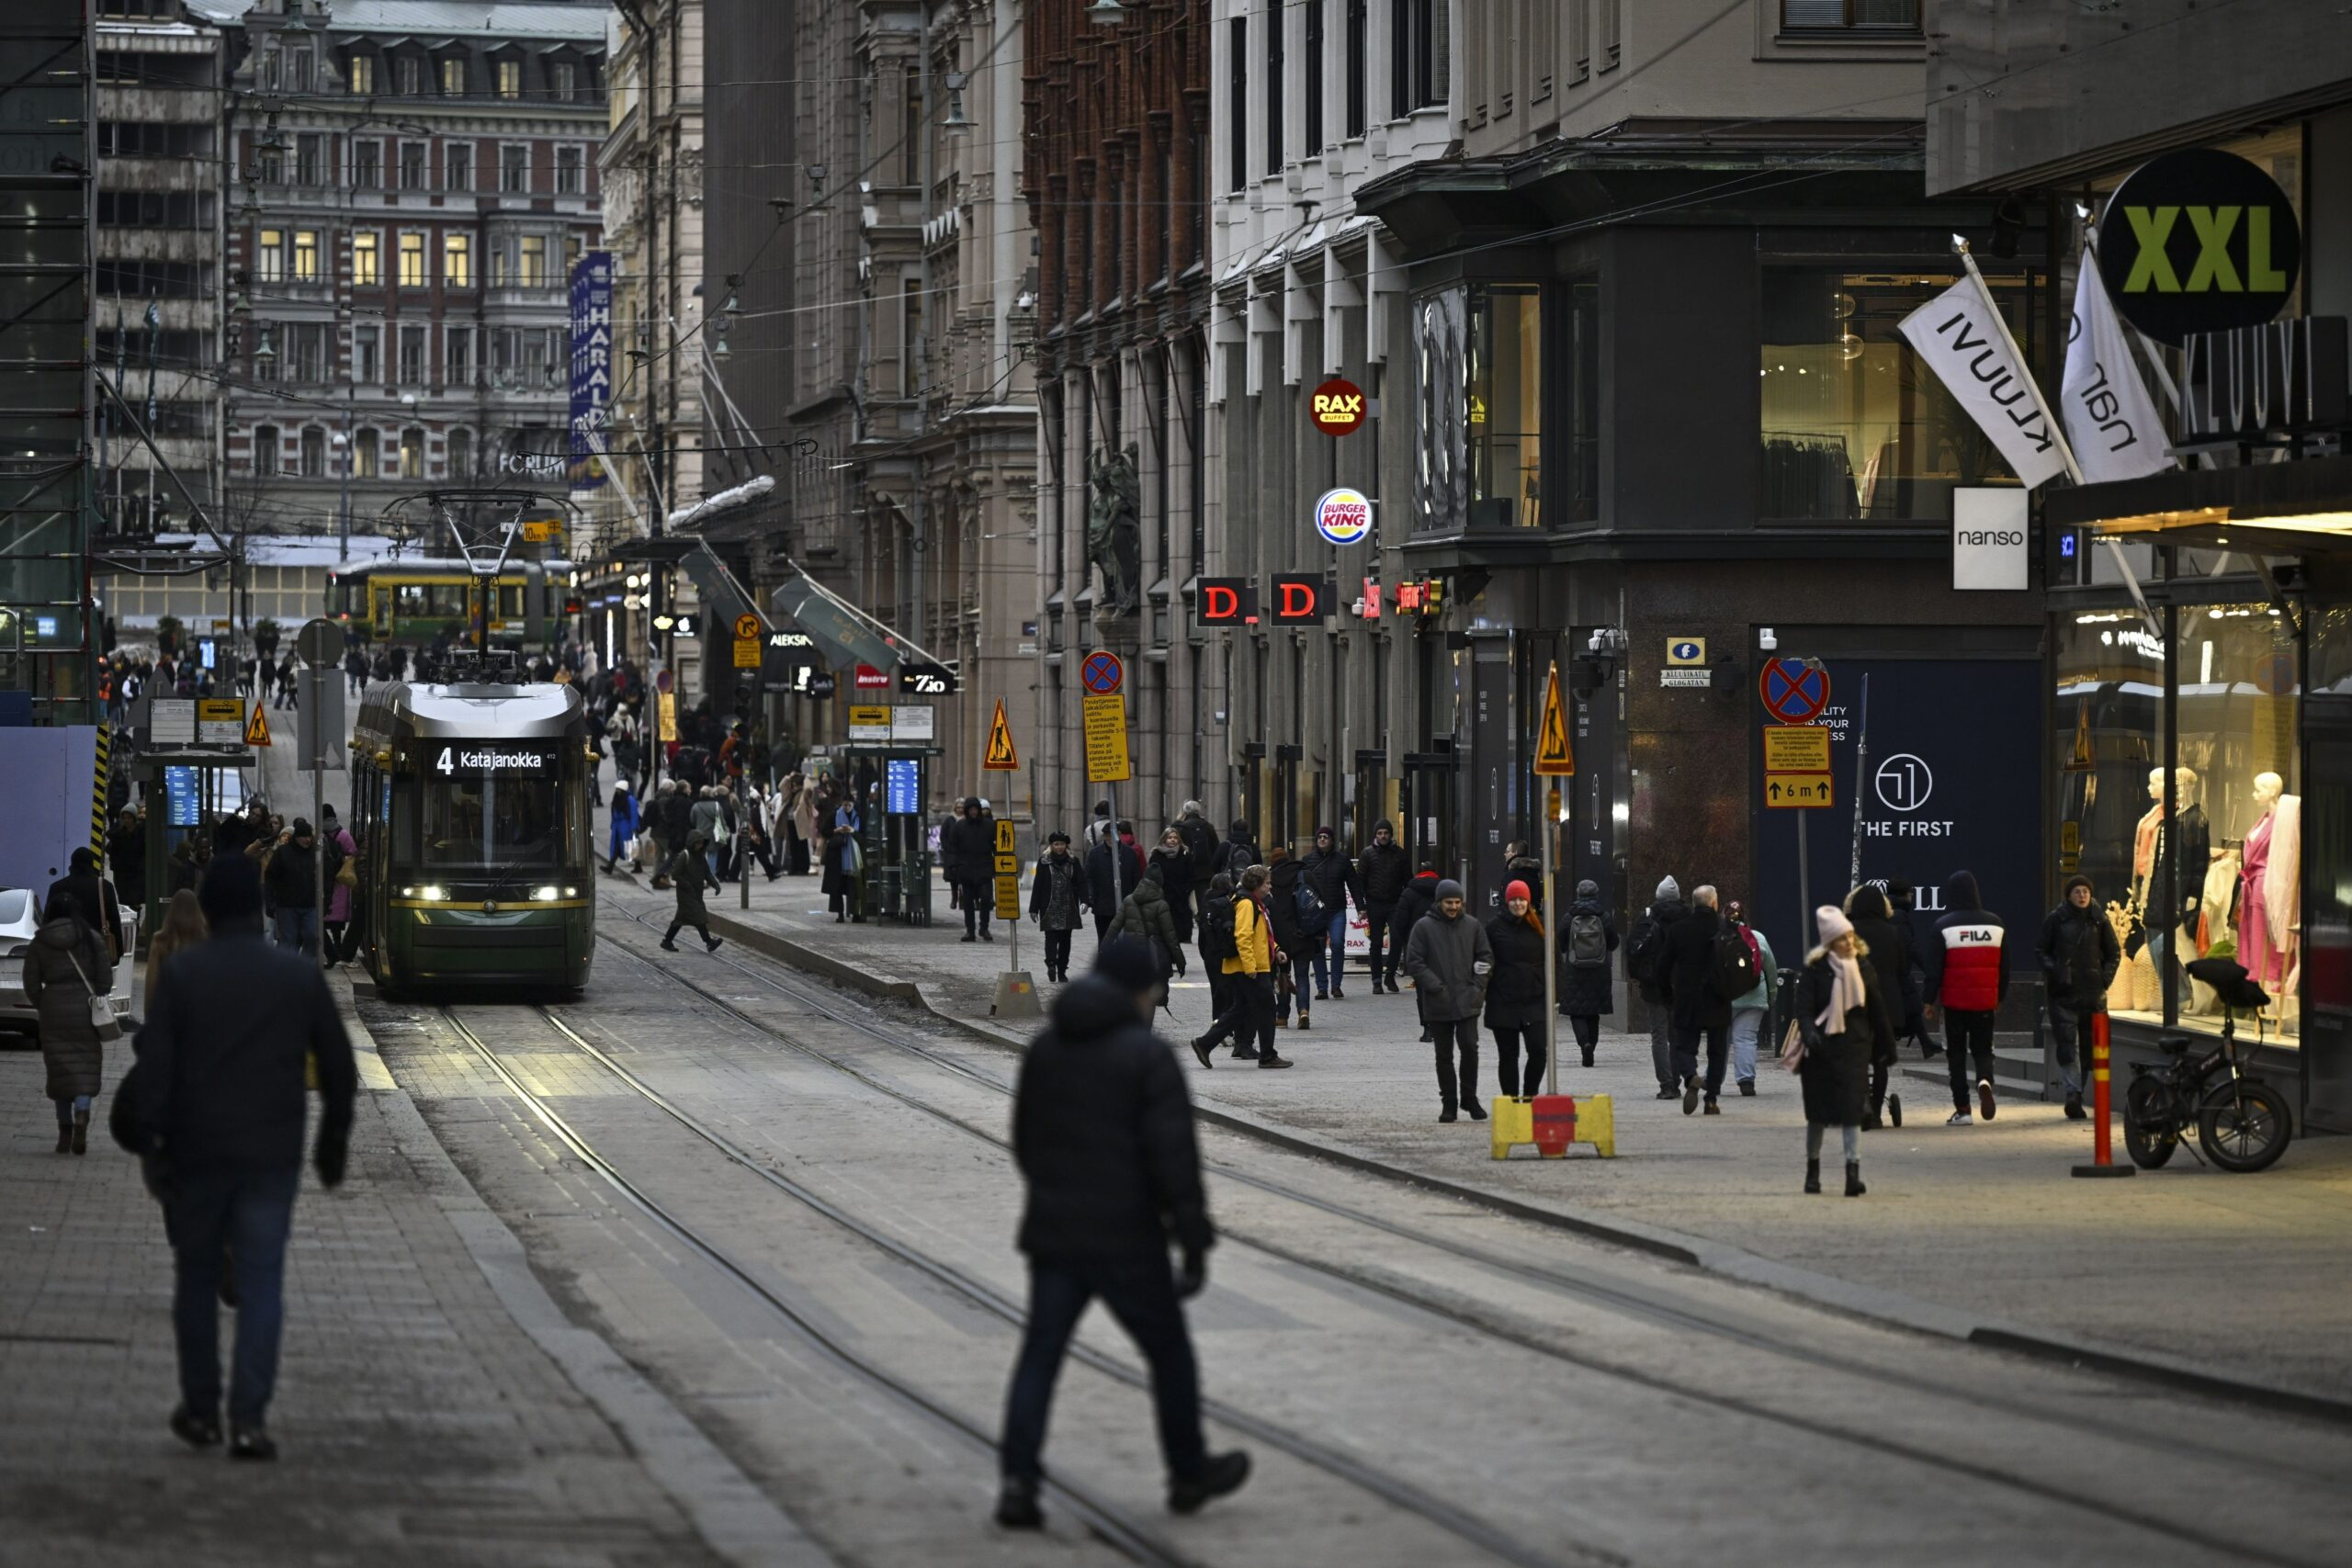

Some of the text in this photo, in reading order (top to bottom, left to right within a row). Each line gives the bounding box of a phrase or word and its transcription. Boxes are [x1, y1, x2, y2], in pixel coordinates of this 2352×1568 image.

[2122, 206, 2287, 293] XXL
[2183, 315, 2312, 434] KLUUVI
[1314, 395, 1362, 413] RAX
[499, 453, 565, 474] FORUM
[1324, 504, 1366, 513] BURGER
[1322, 513, 1366, 527] KING
[1958, 531, 2023, 546] nanso
[916, 675, 945, 692] Zio
[437, 747, 454, 775] 4
[461, 752, 541, 771] Katajanokka
[1787, 784, 1811, 797] 6 m
[1899, 821, 1953, 836] FIRST
[1960, 931, 1992, 942] FILA
